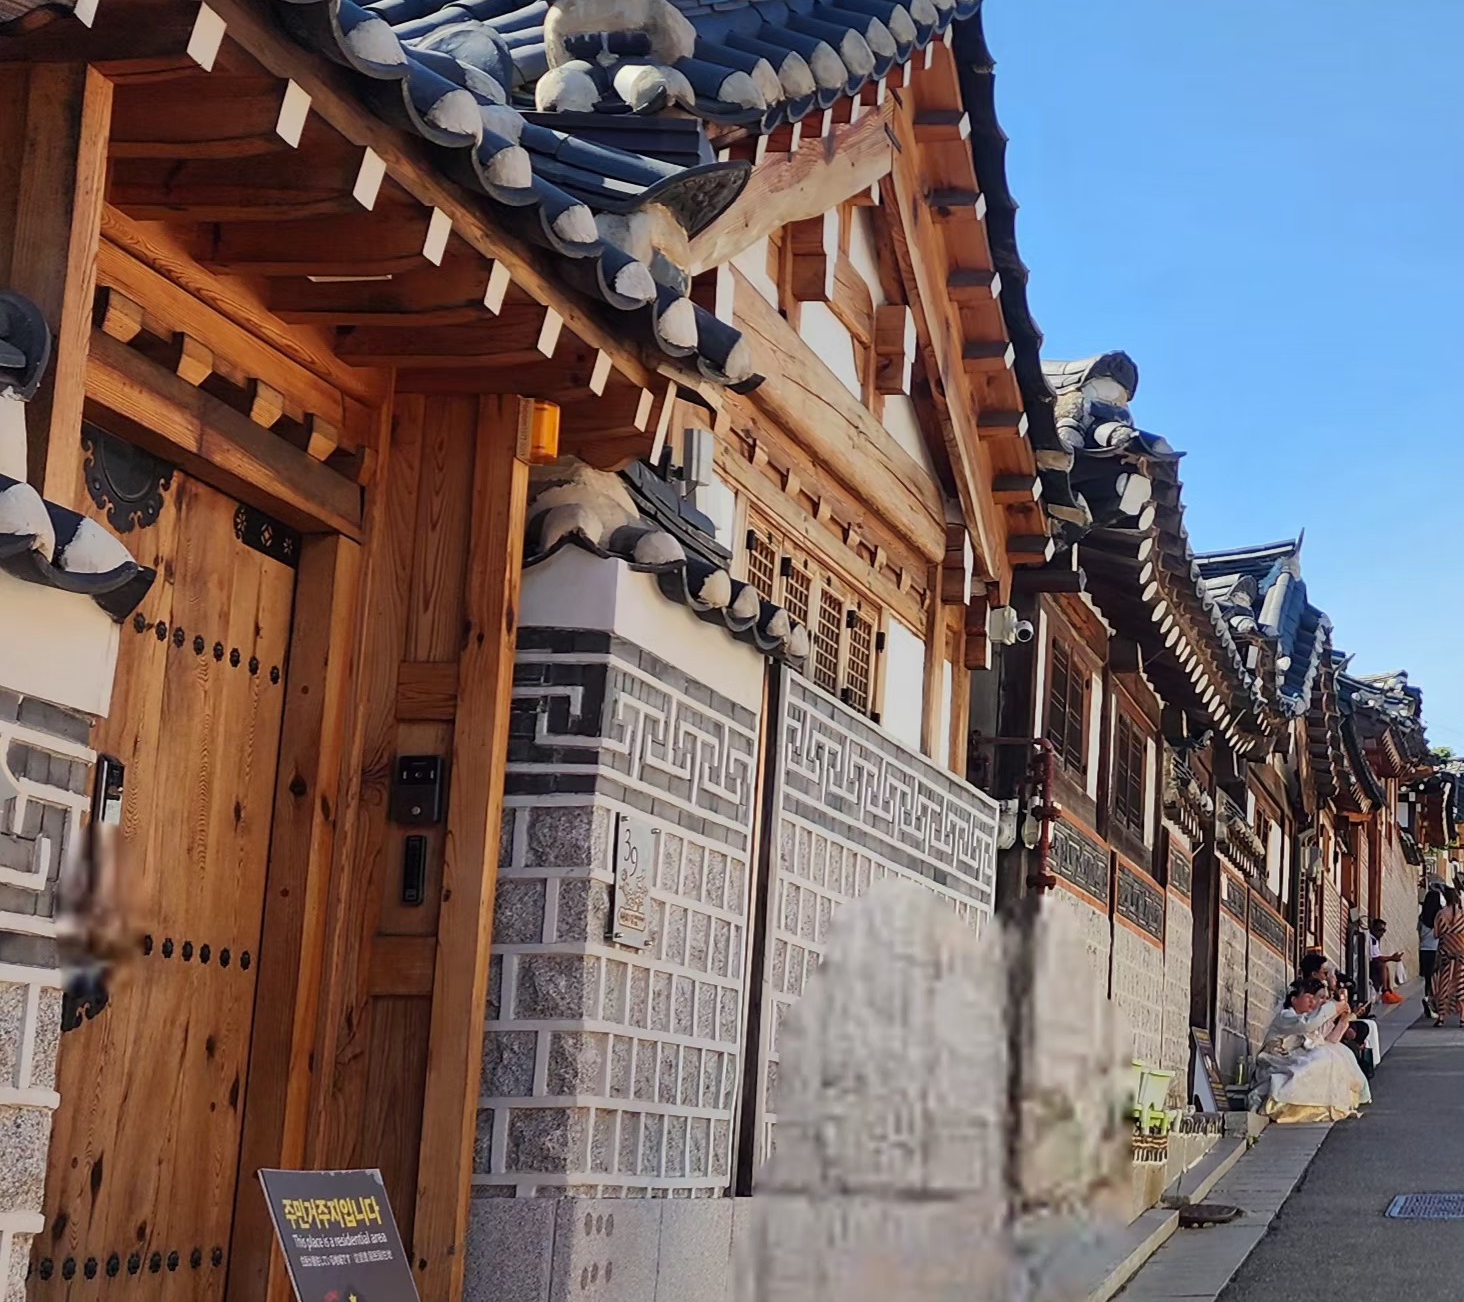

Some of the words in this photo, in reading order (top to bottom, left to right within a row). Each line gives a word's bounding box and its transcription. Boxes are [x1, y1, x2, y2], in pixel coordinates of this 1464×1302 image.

[623, 828, 638, 877] 39
[282, 1196, 382, 1230] 주민거주지입니다
[292, 1233, 307, 1249] This
[305, 1234, 324, 1251] place
[334, 1230, 371, 1247] residential
[370, 1232, 388, 1244] area
